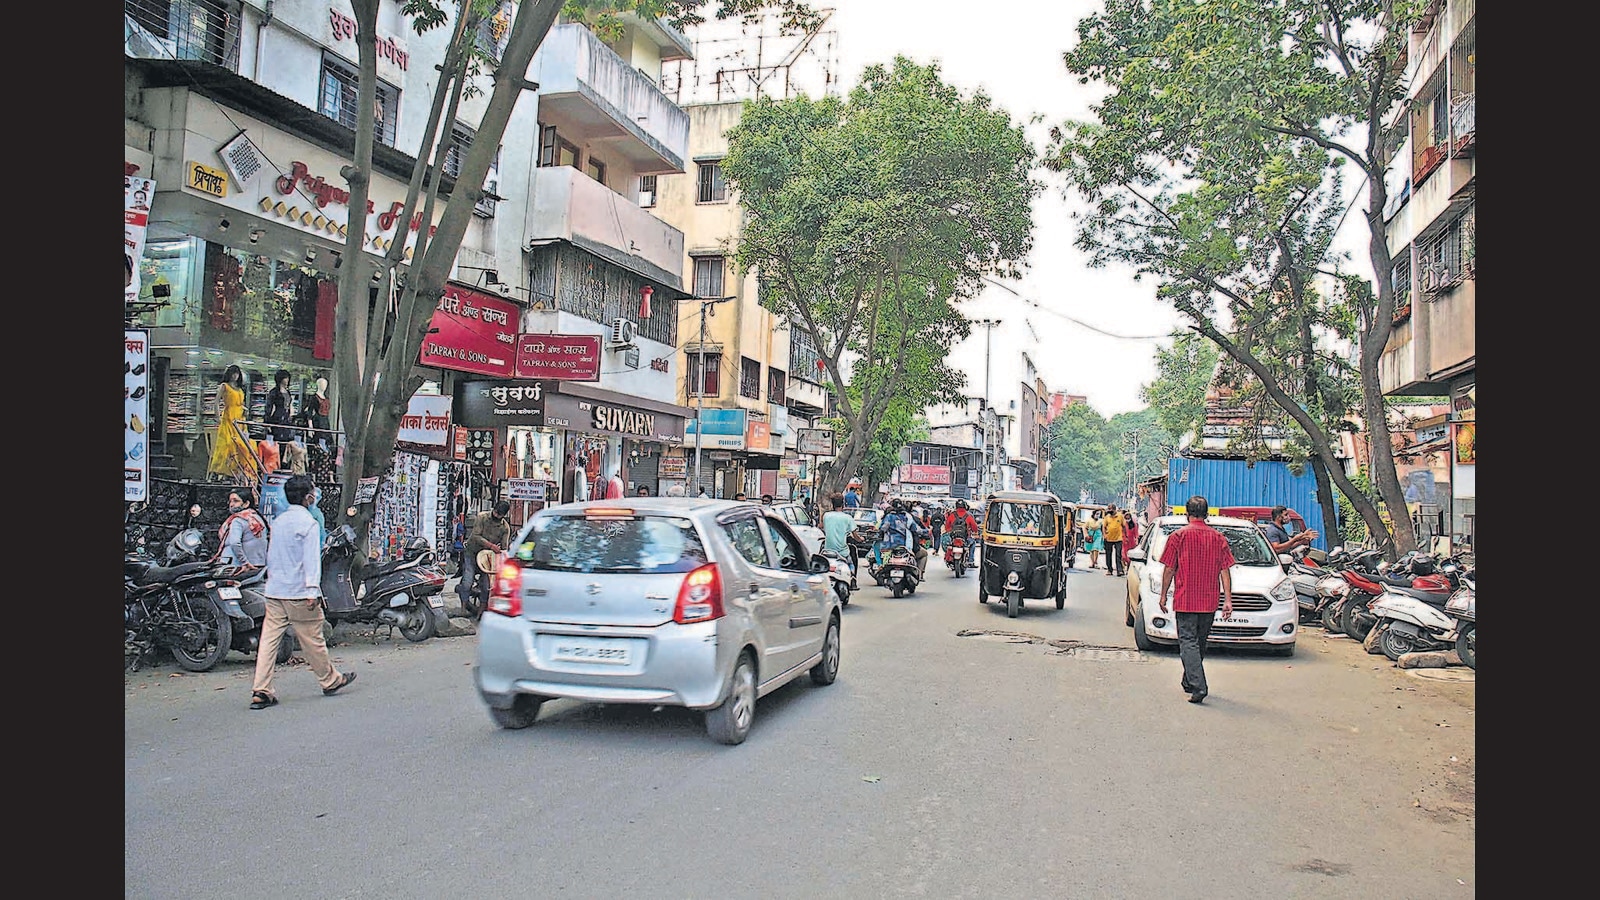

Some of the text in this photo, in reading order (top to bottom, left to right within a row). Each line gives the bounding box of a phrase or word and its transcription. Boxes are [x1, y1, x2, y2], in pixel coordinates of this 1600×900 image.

[329, 7, 359, 41] सुव
[276, 160, 374, 215] Priyana
[481, 306, 508, 325] सन्स
[428, 343, 458, 358] TAPRAY
[459, 348, 466, 360] &
[467, 351, 487, 364] SONS
[523, 341, 545, 354] टापरे
[563, 345, 588, 355] सन्स
[523, 359, 549, 367] TAPRAY
[557, 361, 577, 369] SONS
[491, 382, 541, 406] सुवर्ण
[425, 410, 449, 430] टेलर्स
[595, 405, 655, 436] SUVARN
